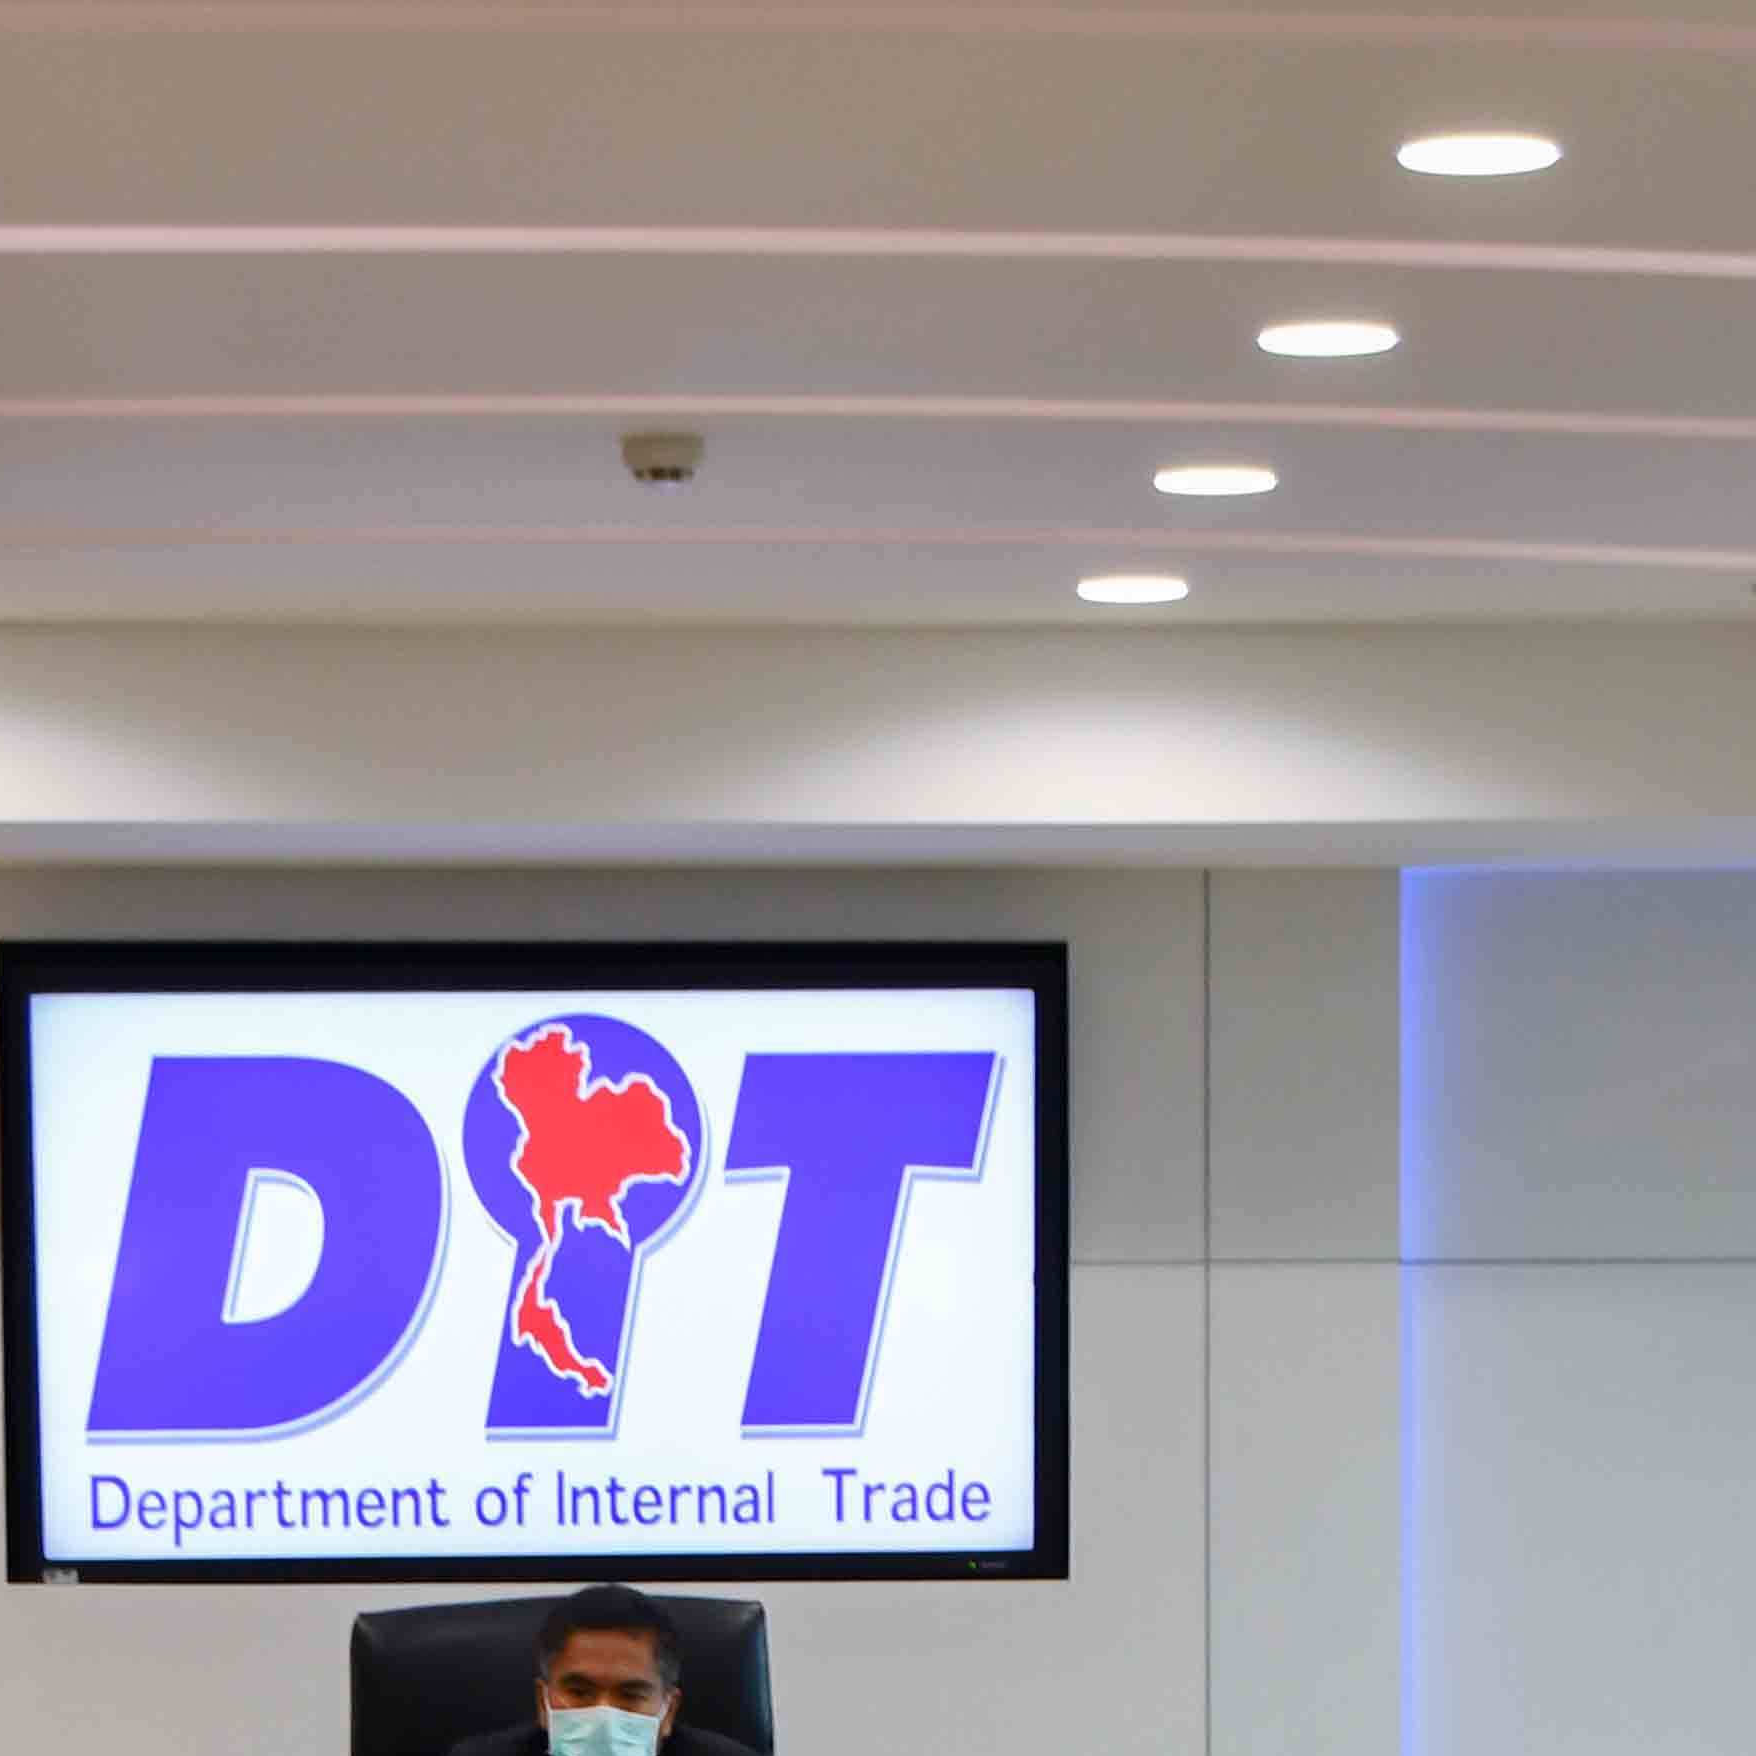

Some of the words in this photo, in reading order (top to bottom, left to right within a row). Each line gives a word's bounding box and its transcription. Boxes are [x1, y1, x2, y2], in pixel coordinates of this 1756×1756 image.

[86, 1012, 1006, 1442] DIT
[88, 1472, 450, 1548] Department
[473, 1470, 533, 1527] of
[556, 1468, 776, 1526] Internal
[821, 1466, 992, 1524] Trade
